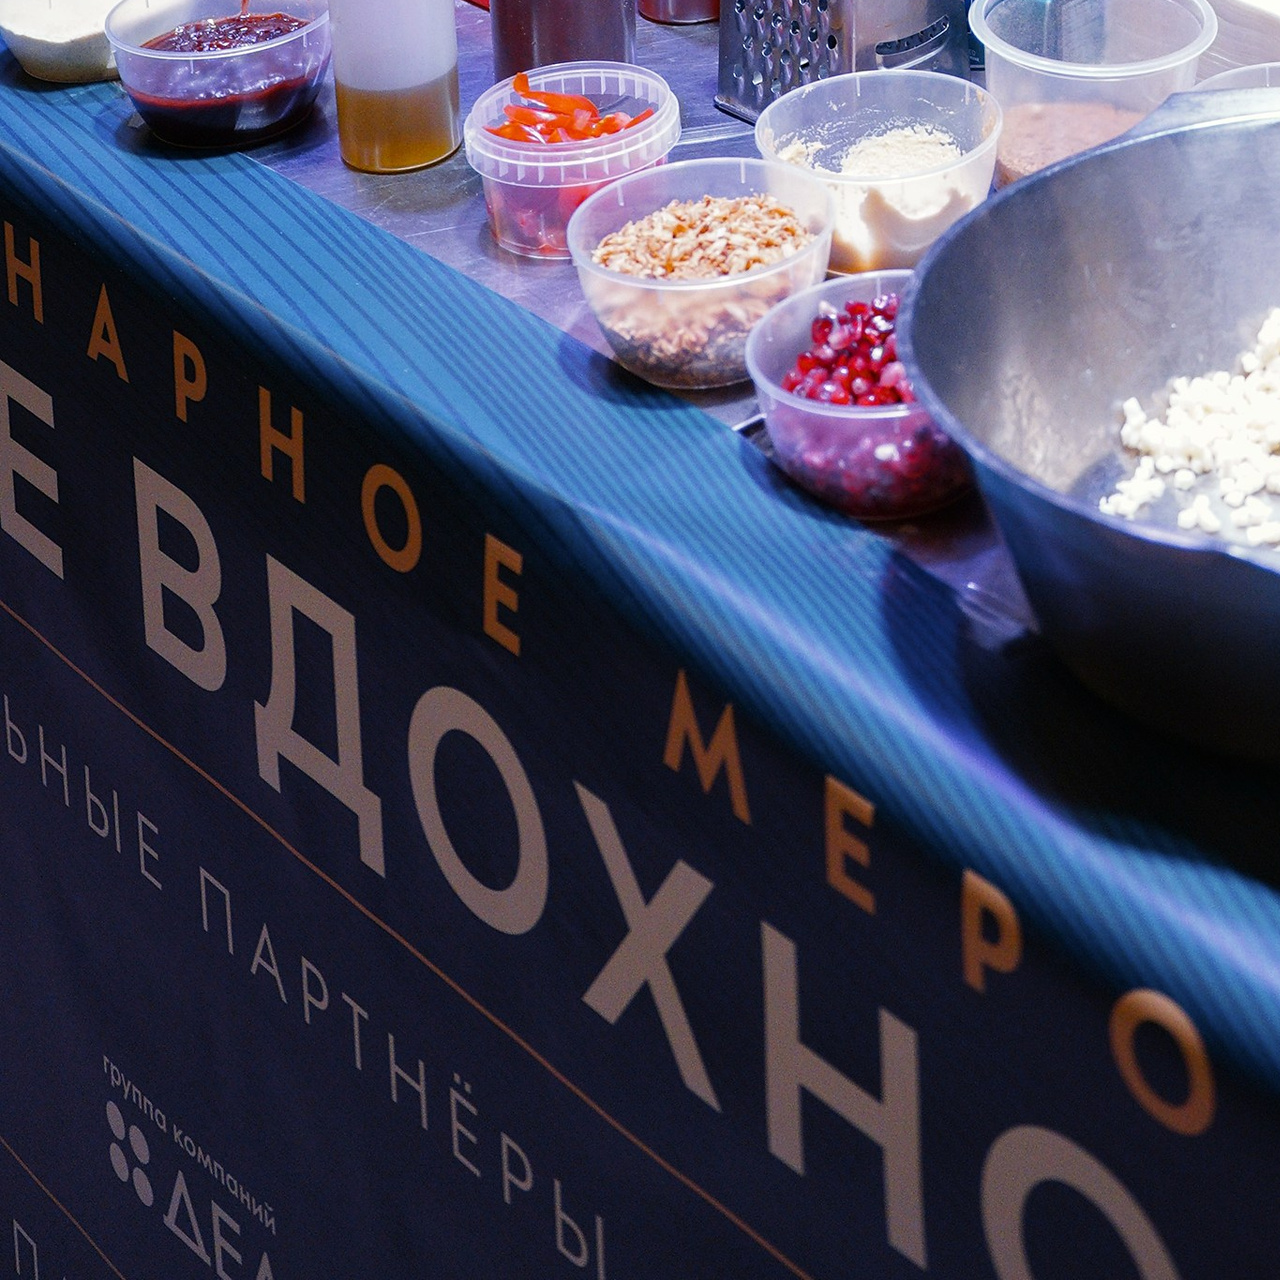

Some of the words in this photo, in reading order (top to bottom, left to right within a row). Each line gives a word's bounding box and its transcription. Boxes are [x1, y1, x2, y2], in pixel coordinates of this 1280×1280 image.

[4, 220, 523, 657] НАРНОЕ
[4, 693, 163, 891] ЬНЫЕ
[199, 866, 606, 1280] ПАРТНЁРЫ
[102, 1055, 168, 1133] группа
[173, 1124, 278, 1236] компаний
